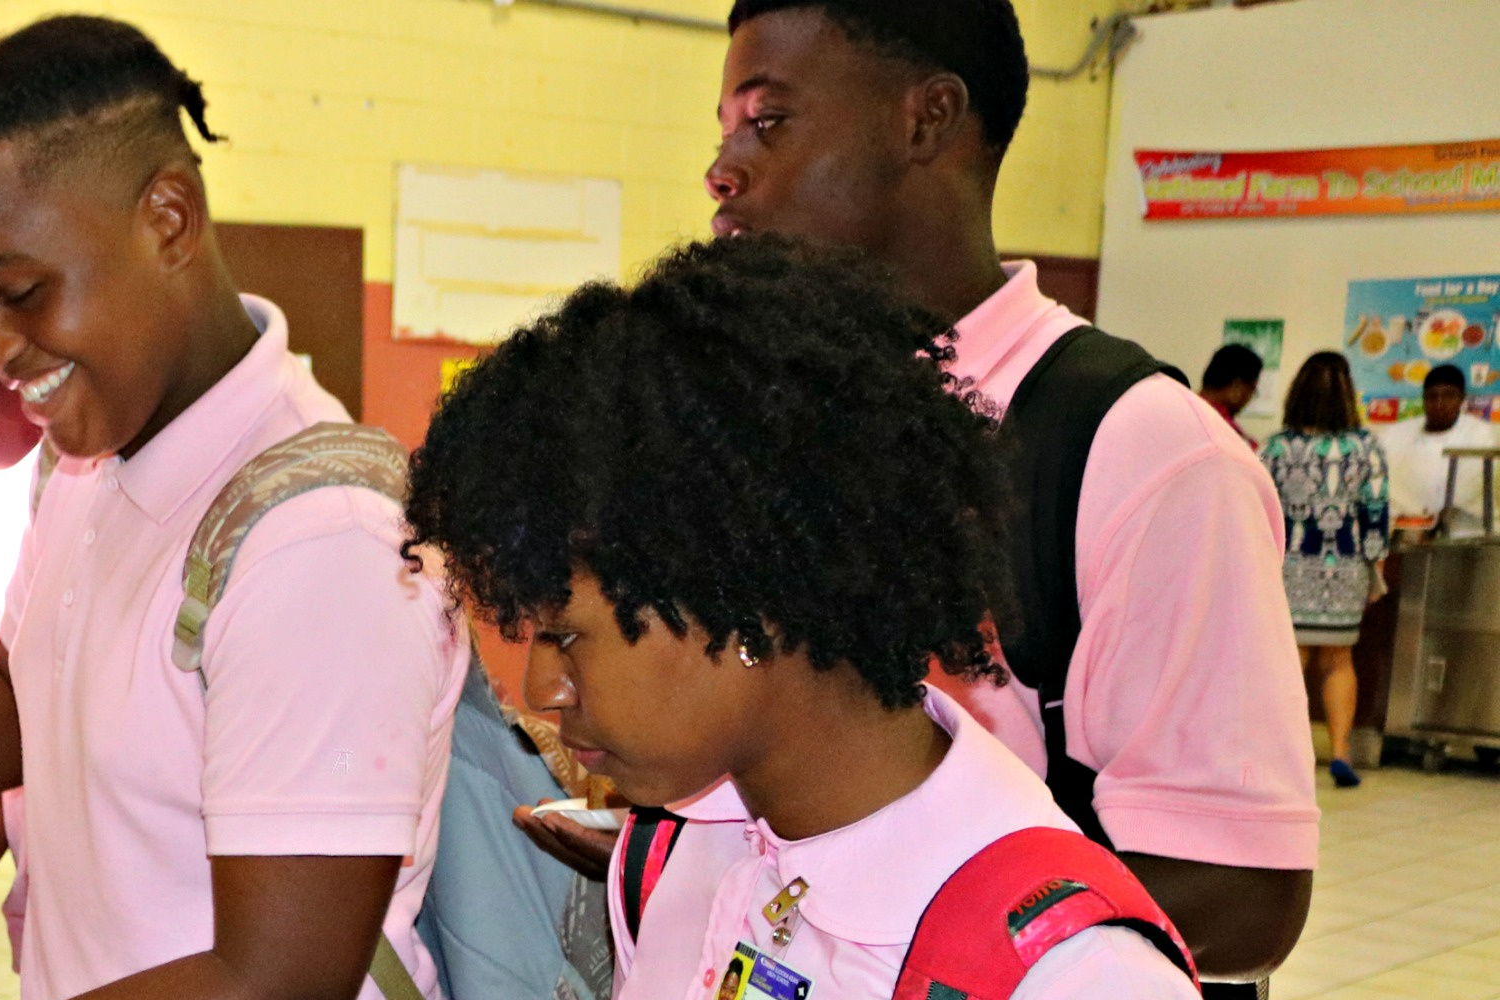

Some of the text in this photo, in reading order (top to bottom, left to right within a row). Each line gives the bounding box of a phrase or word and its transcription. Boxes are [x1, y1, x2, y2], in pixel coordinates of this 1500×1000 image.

[1250, 172, 1319, 200] Farm
[1323, 170, 1359, 199] To
[1362, 164, 1464, 198] School
